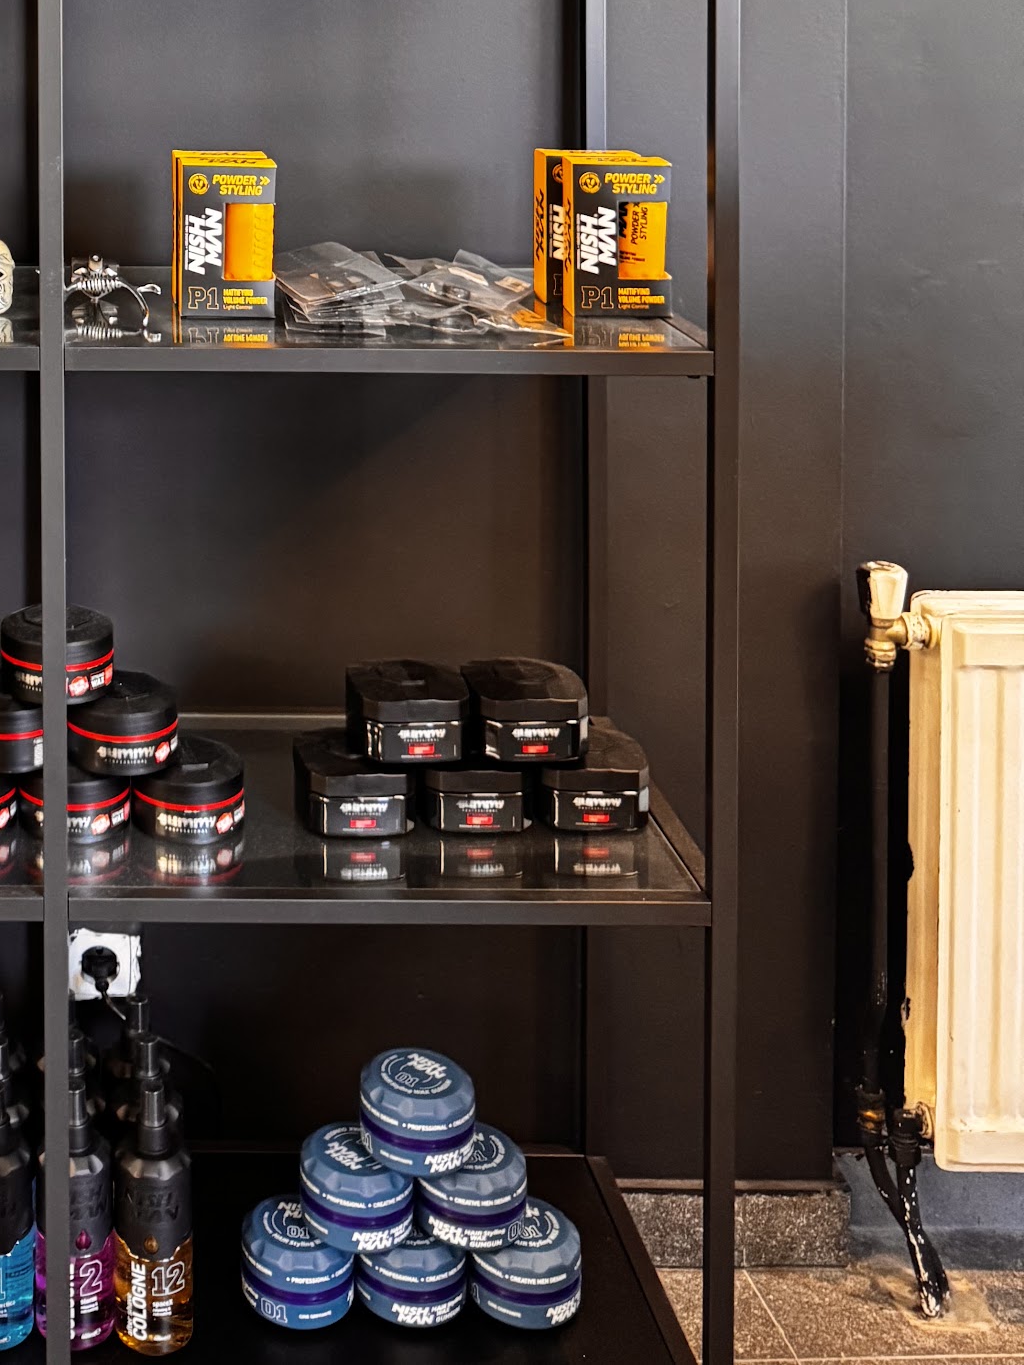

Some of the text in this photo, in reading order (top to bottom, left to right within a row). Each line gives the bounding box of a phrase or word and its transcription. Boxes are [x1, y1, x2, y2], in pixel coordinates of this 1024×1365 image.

[212, 174, 257, 185] POWDER
[605, 173, 651, 184] POWDER
[219, 185, 262, 196] STYLING
[612, 184, 657, 195] STYLING
[631, 211, 640, 245] POWDER
[640, 206, 648, 240] STYLING
[205, 207, 222, 267] MAN
[598, 206, 617, 267] MAN
[188, 286, 219, 310] P1
[245, 297, 268, 305] POWDER
[582, 286, 614, 309] P1
[642, 296, 665, 305] POWDER
[407, 1123, 448, 1131] PROFESSIONAL
[430, 1155, 461, 1173] MAN
[326, 1194, 366, 1208] PROFESSIONAL
[287, 1225, 310, 1239] 01
[433, 1229, 468, 1246] MAN
[465, 1228, 506, 1238] HAIR Styling
[357, 1237, 392, 1251] MAN
[80, 1259, 102, 1297] 2
[151, 1260, 185, 1296] 12
[291, 1275, 330, 1284] PROFESSIONAL
[379, 1267, 419, 1283] PROFESSIONAL
[131, 1260, 147, 1341] COLOGNE
[261, 1298, 287, 1323] 01
[397, 1314, 434, 1325] MAN
